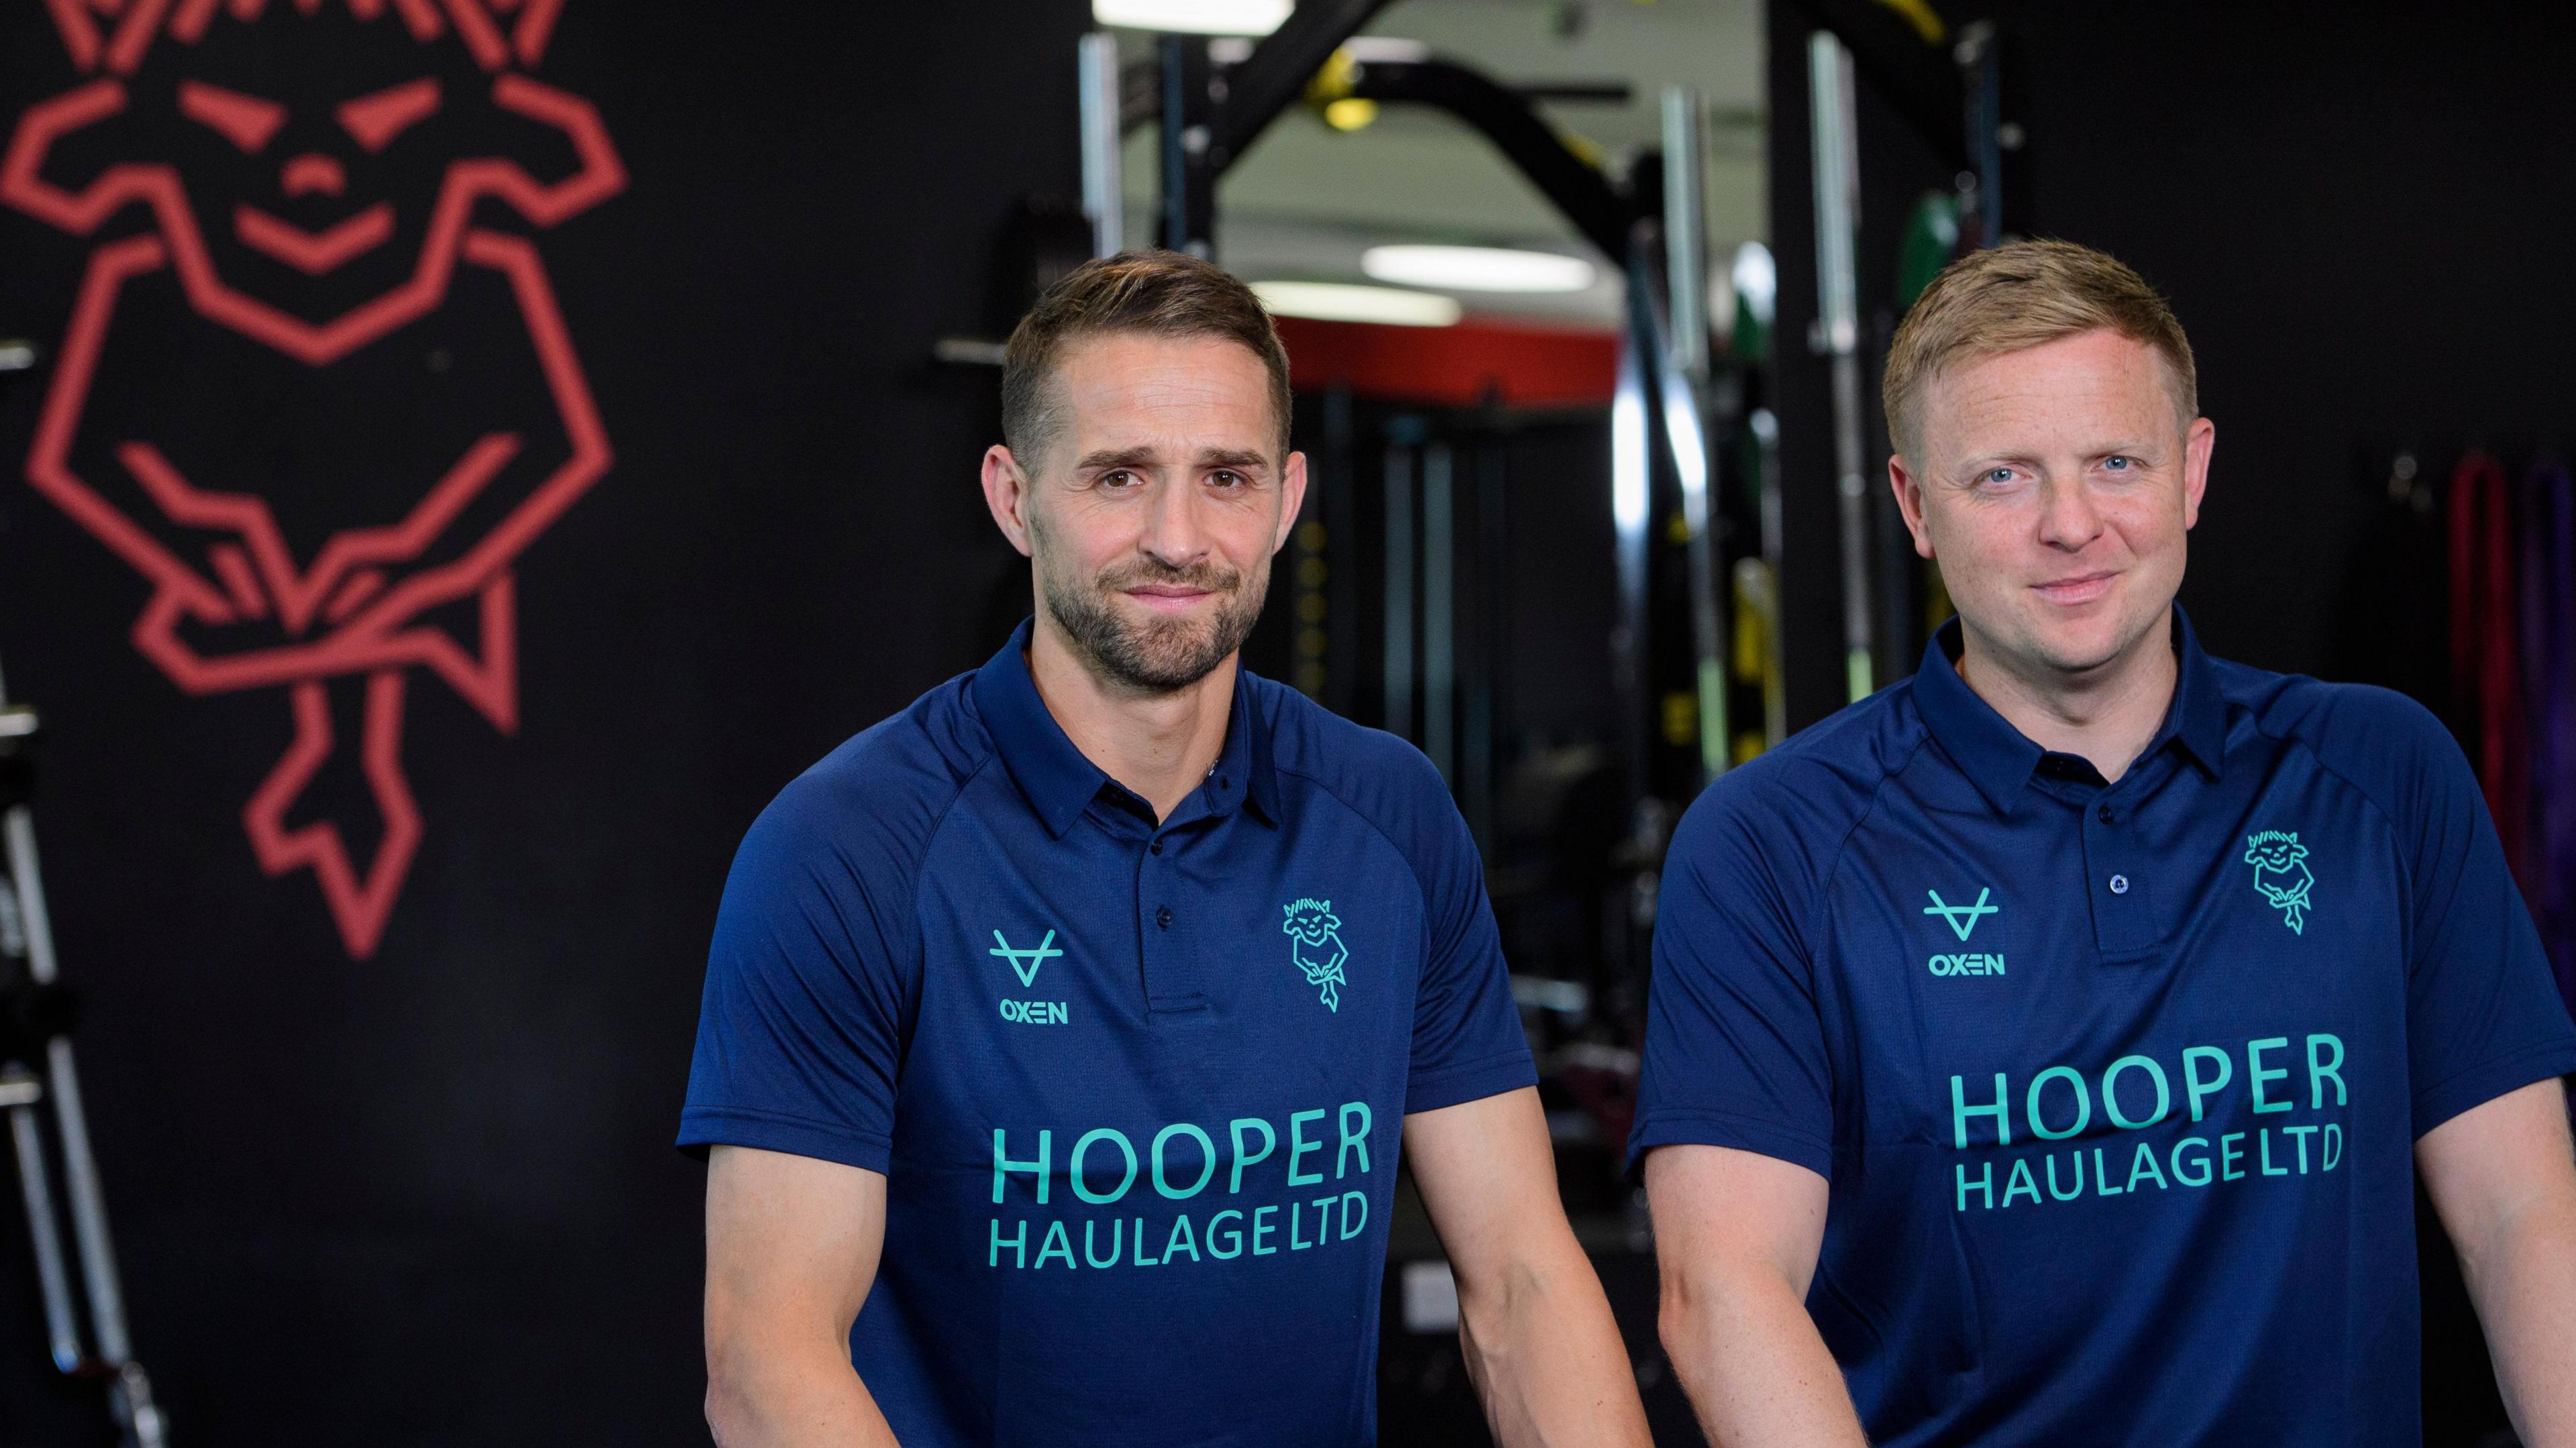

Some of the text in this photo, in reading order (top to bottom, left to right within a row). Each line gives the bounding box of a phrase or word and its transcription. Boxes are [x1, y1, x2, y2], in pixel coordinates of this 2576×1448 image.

[1928, 953, 2006, 977] OXEN
[999, 998, 1069, 1025] OXEN
[1950, 1033, 2347, 1149] HOOPER
[992, 1101, 1372, 1205] HOOPER
[1955, 1123, 2343, 1212] HAULAGE LTD
[989, 1190, 1368, 1270] HAULAGE LTD
